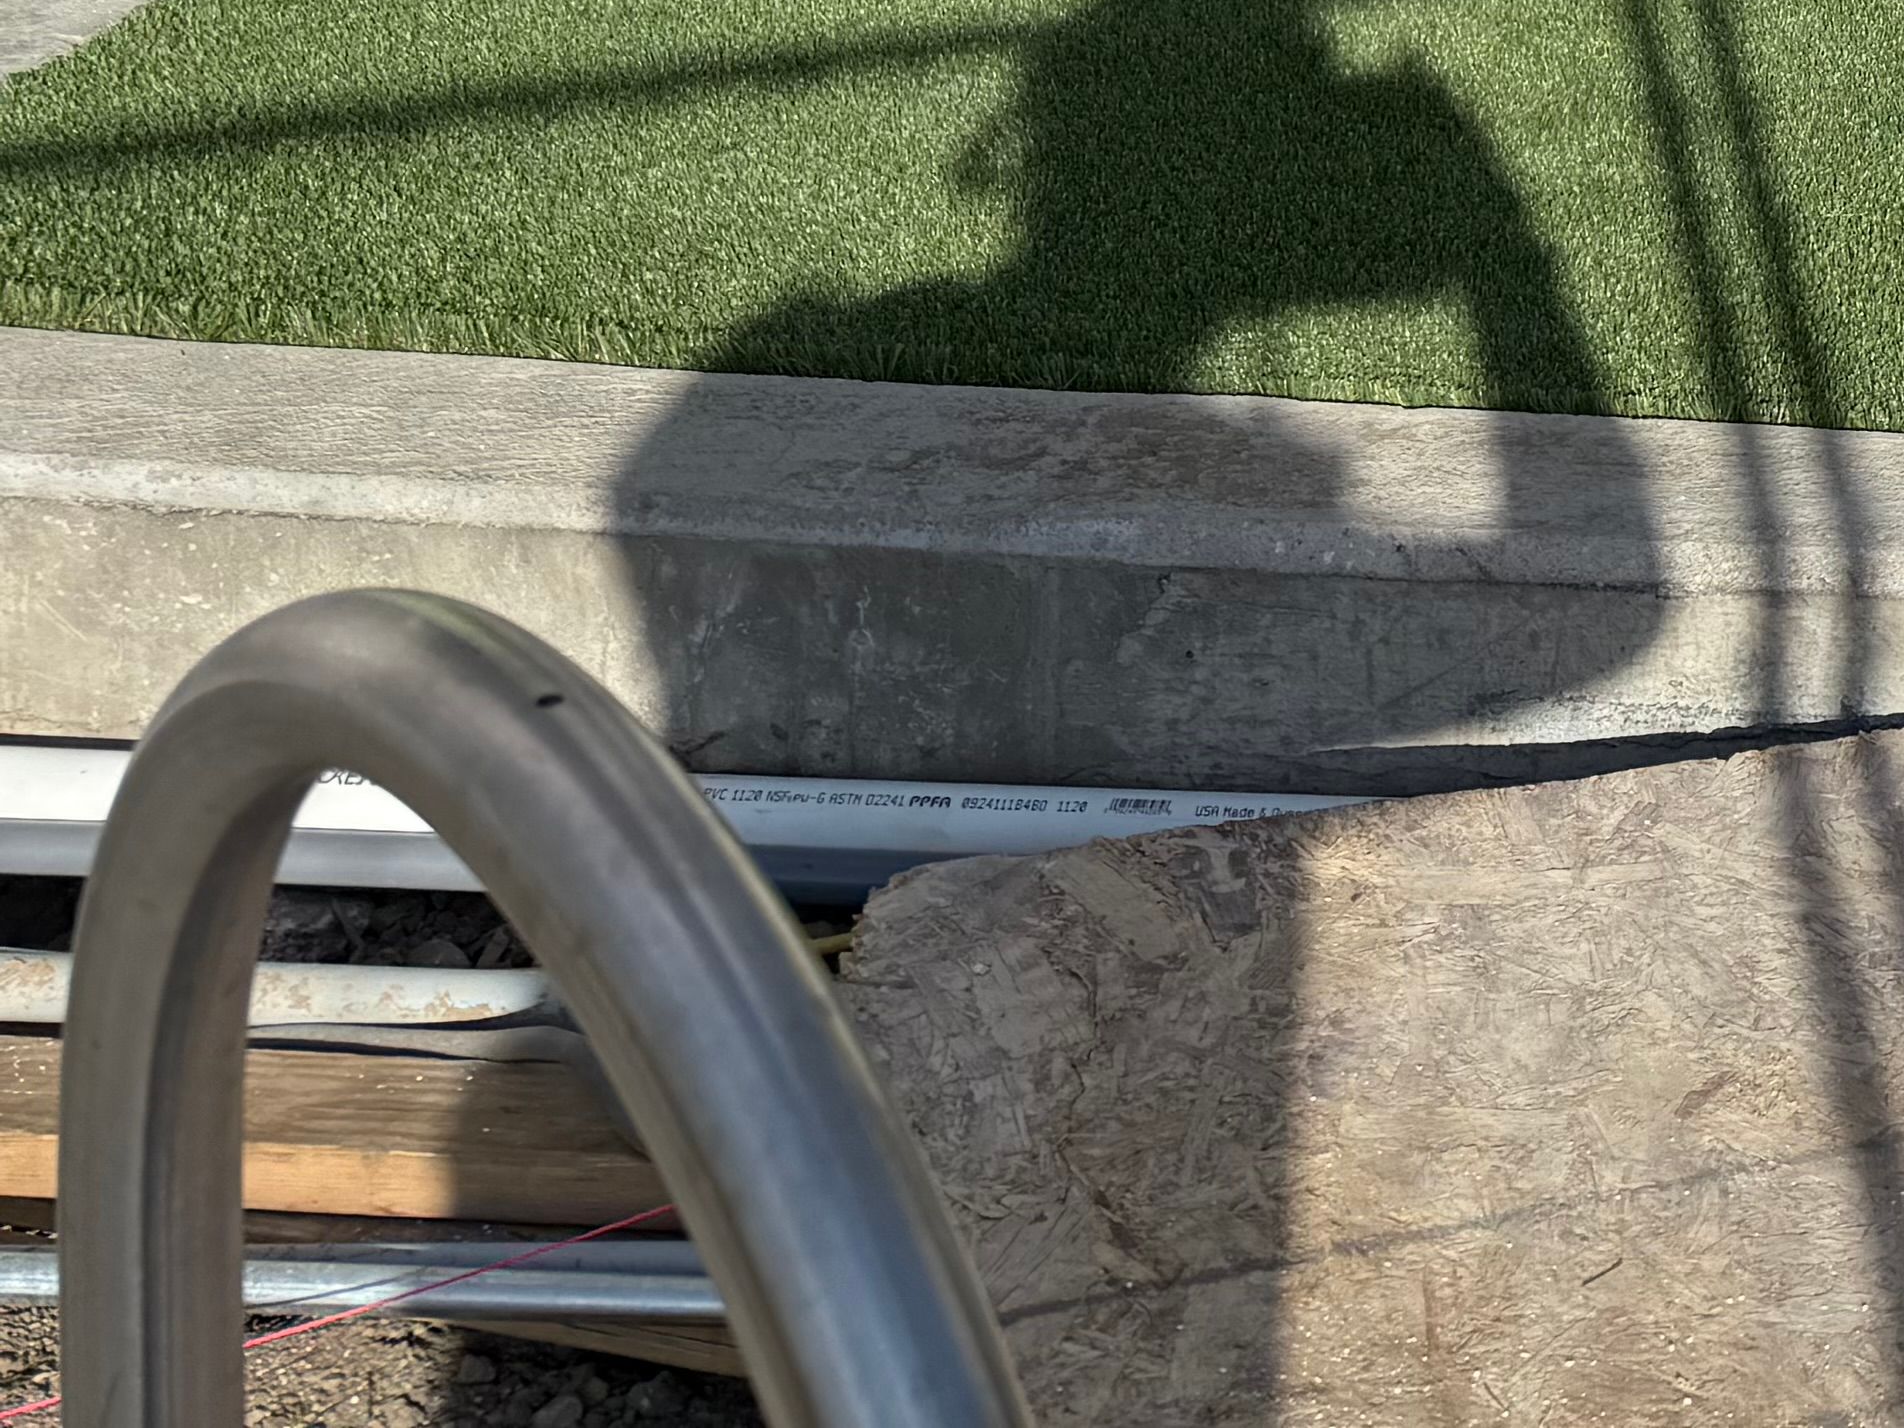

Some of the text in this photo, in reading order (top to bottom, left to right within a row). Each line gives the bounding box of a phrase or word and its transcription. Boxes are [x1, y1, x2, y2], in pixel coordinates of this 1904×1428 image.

[731, 789, 763, 802] 1120
[829, 793, 863, 805] ASTM
[909, 795, 952, 809] PPFA
[1056, 800, 1088, 812] 1120
[1195, 805, 1220, 817] USA
[1223, 806, 1256, 818] Made
